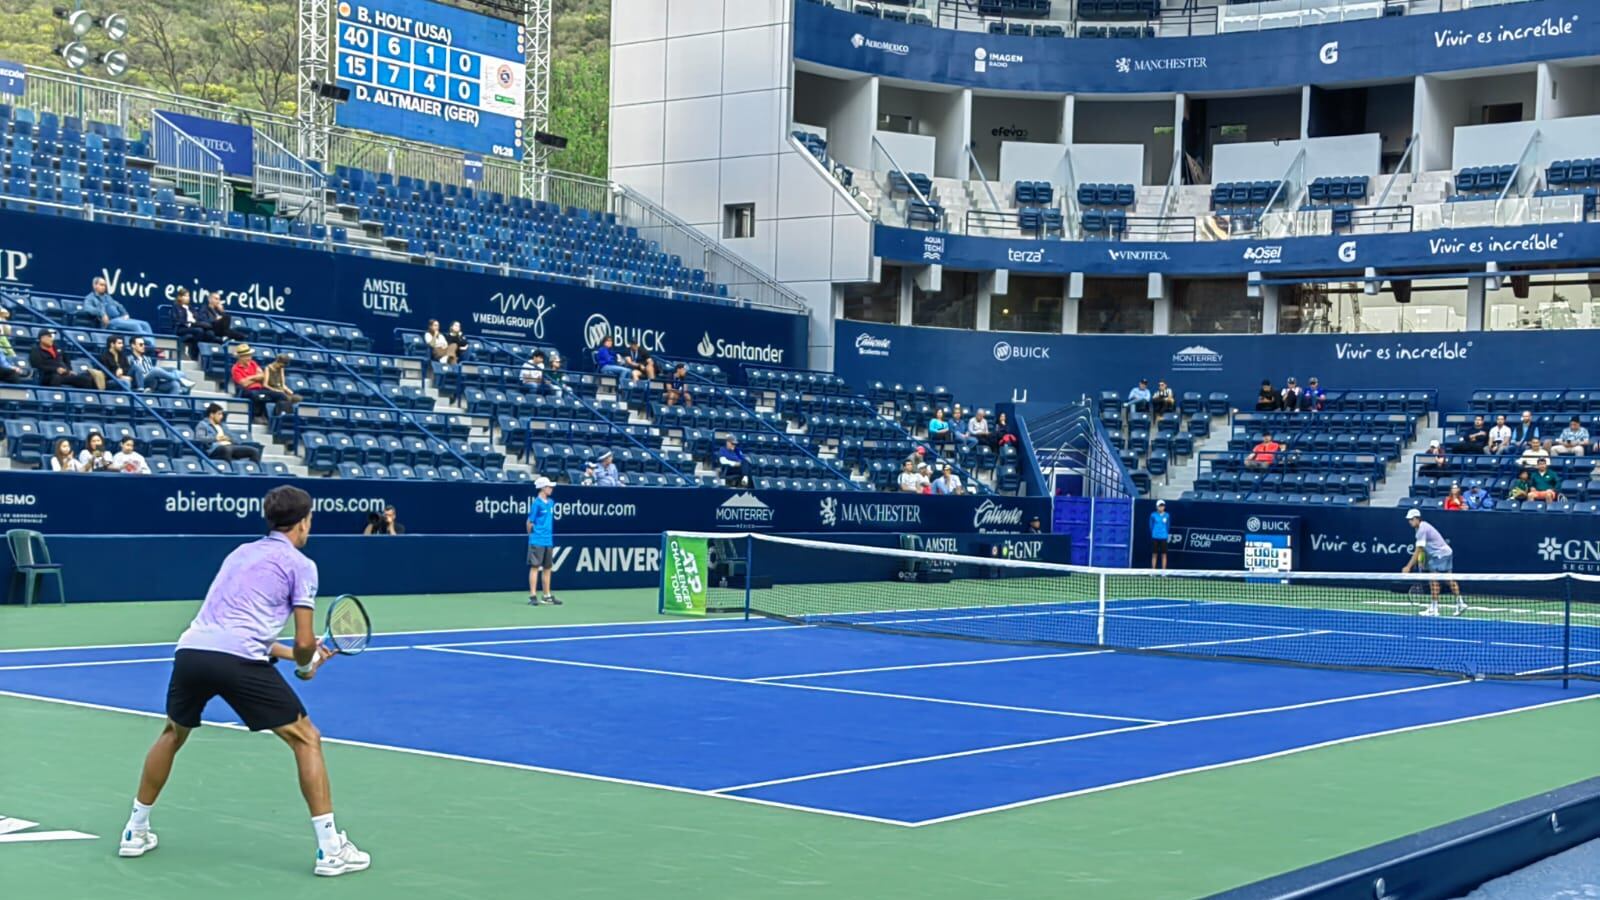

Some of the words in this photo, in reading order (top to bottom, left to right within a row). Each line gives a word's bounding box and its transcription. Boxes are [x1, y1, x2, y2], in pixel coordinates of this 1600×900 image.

[357, 7, 372, 23] B.
[375, 12, 412, 33] HOLT
[415, 20, 452, 45] (USA)
[1434, 30, 1473, 48] Vivir
[1477, 31, 1493, 44] es
[1497, 17, 1573, 42] increíble
[344, 26, 369, 49] 40
[388, 38, 400, 56] 6
[426, 46, 434, 64] 1
[459, 55, 471, 73] 0
[989, 53, 1023, 63] IMAGEN
[1134, 57, 1208, 71] MANCHESTER
[345, 56, 366, 77] 15
[389, 65, 400, 84] 7
[424, 74, 436, 92] 4
[459, 82, 471, 100] 0
[356, 85, 371, 101] D.
[374, 88, 441, 118] ALTMAIER
[444, 103, 480, 127] (GER)
[924, 236, 941, 244] AQUA
[924, 243, 941, 253] TECH
[1429, 237, 1463, 255] Vivir
[1469, 240, 1484, 253] es
[1488, 233, 1559, 252] increíble
[1008, 248, 1043, 263] terza
[1254, 246, 1282, 259] Osel
[0, 249, 28, 281] P
[102, 268, 159, 298] Vivir
[363, 278, 408, 296] AMSTEL
[362, 292, 410, 313] ULTRA
[472, 312, 480, 323] V
[480, 313, 505, 325] MEDIA
[506, 316, 535, 328] GROUP
[614, 325, 666, 352] BUICK
[716, 338, 784, 363] Santander
[1013, 346, 1050, 360] BUICK
[1172, 354, 1223, 362] MONTERREY
[1335, 343, 1372, 360] Vivir
[1376, 347, 1390, 360] es
[1395, 342, 1468, 360] increíble
[0, 494, 36, 505] ISMO
[165, 489, 385, 519] abiertognuros.com
[475, 496, 636, 520] atpchalgertour.com
[716, 508, 775, 521] MONTERREY
[841, 504, 921, 524] MANCHESTER
[974, 498, 1023, 528] Caliente
[1262, 521, 1290, 531] BUICK
[925, 537, 958, 552] AMSTEL
[1190, 532, 1242, 543] CHALLENGER
[1190, 540, 1211, 548] TOUR
[1310, 533, 1348, 552] Vivir
[1352, 541, 1367, 554] es
[1371, 537, 1415, 555] incre
[1014, 541, 1041, 559] GNP
[671, 541, 693, 609] CHALLENGER
[680, 548, 702, 593] ATP
[671, 574, 683, 603] TOUR
